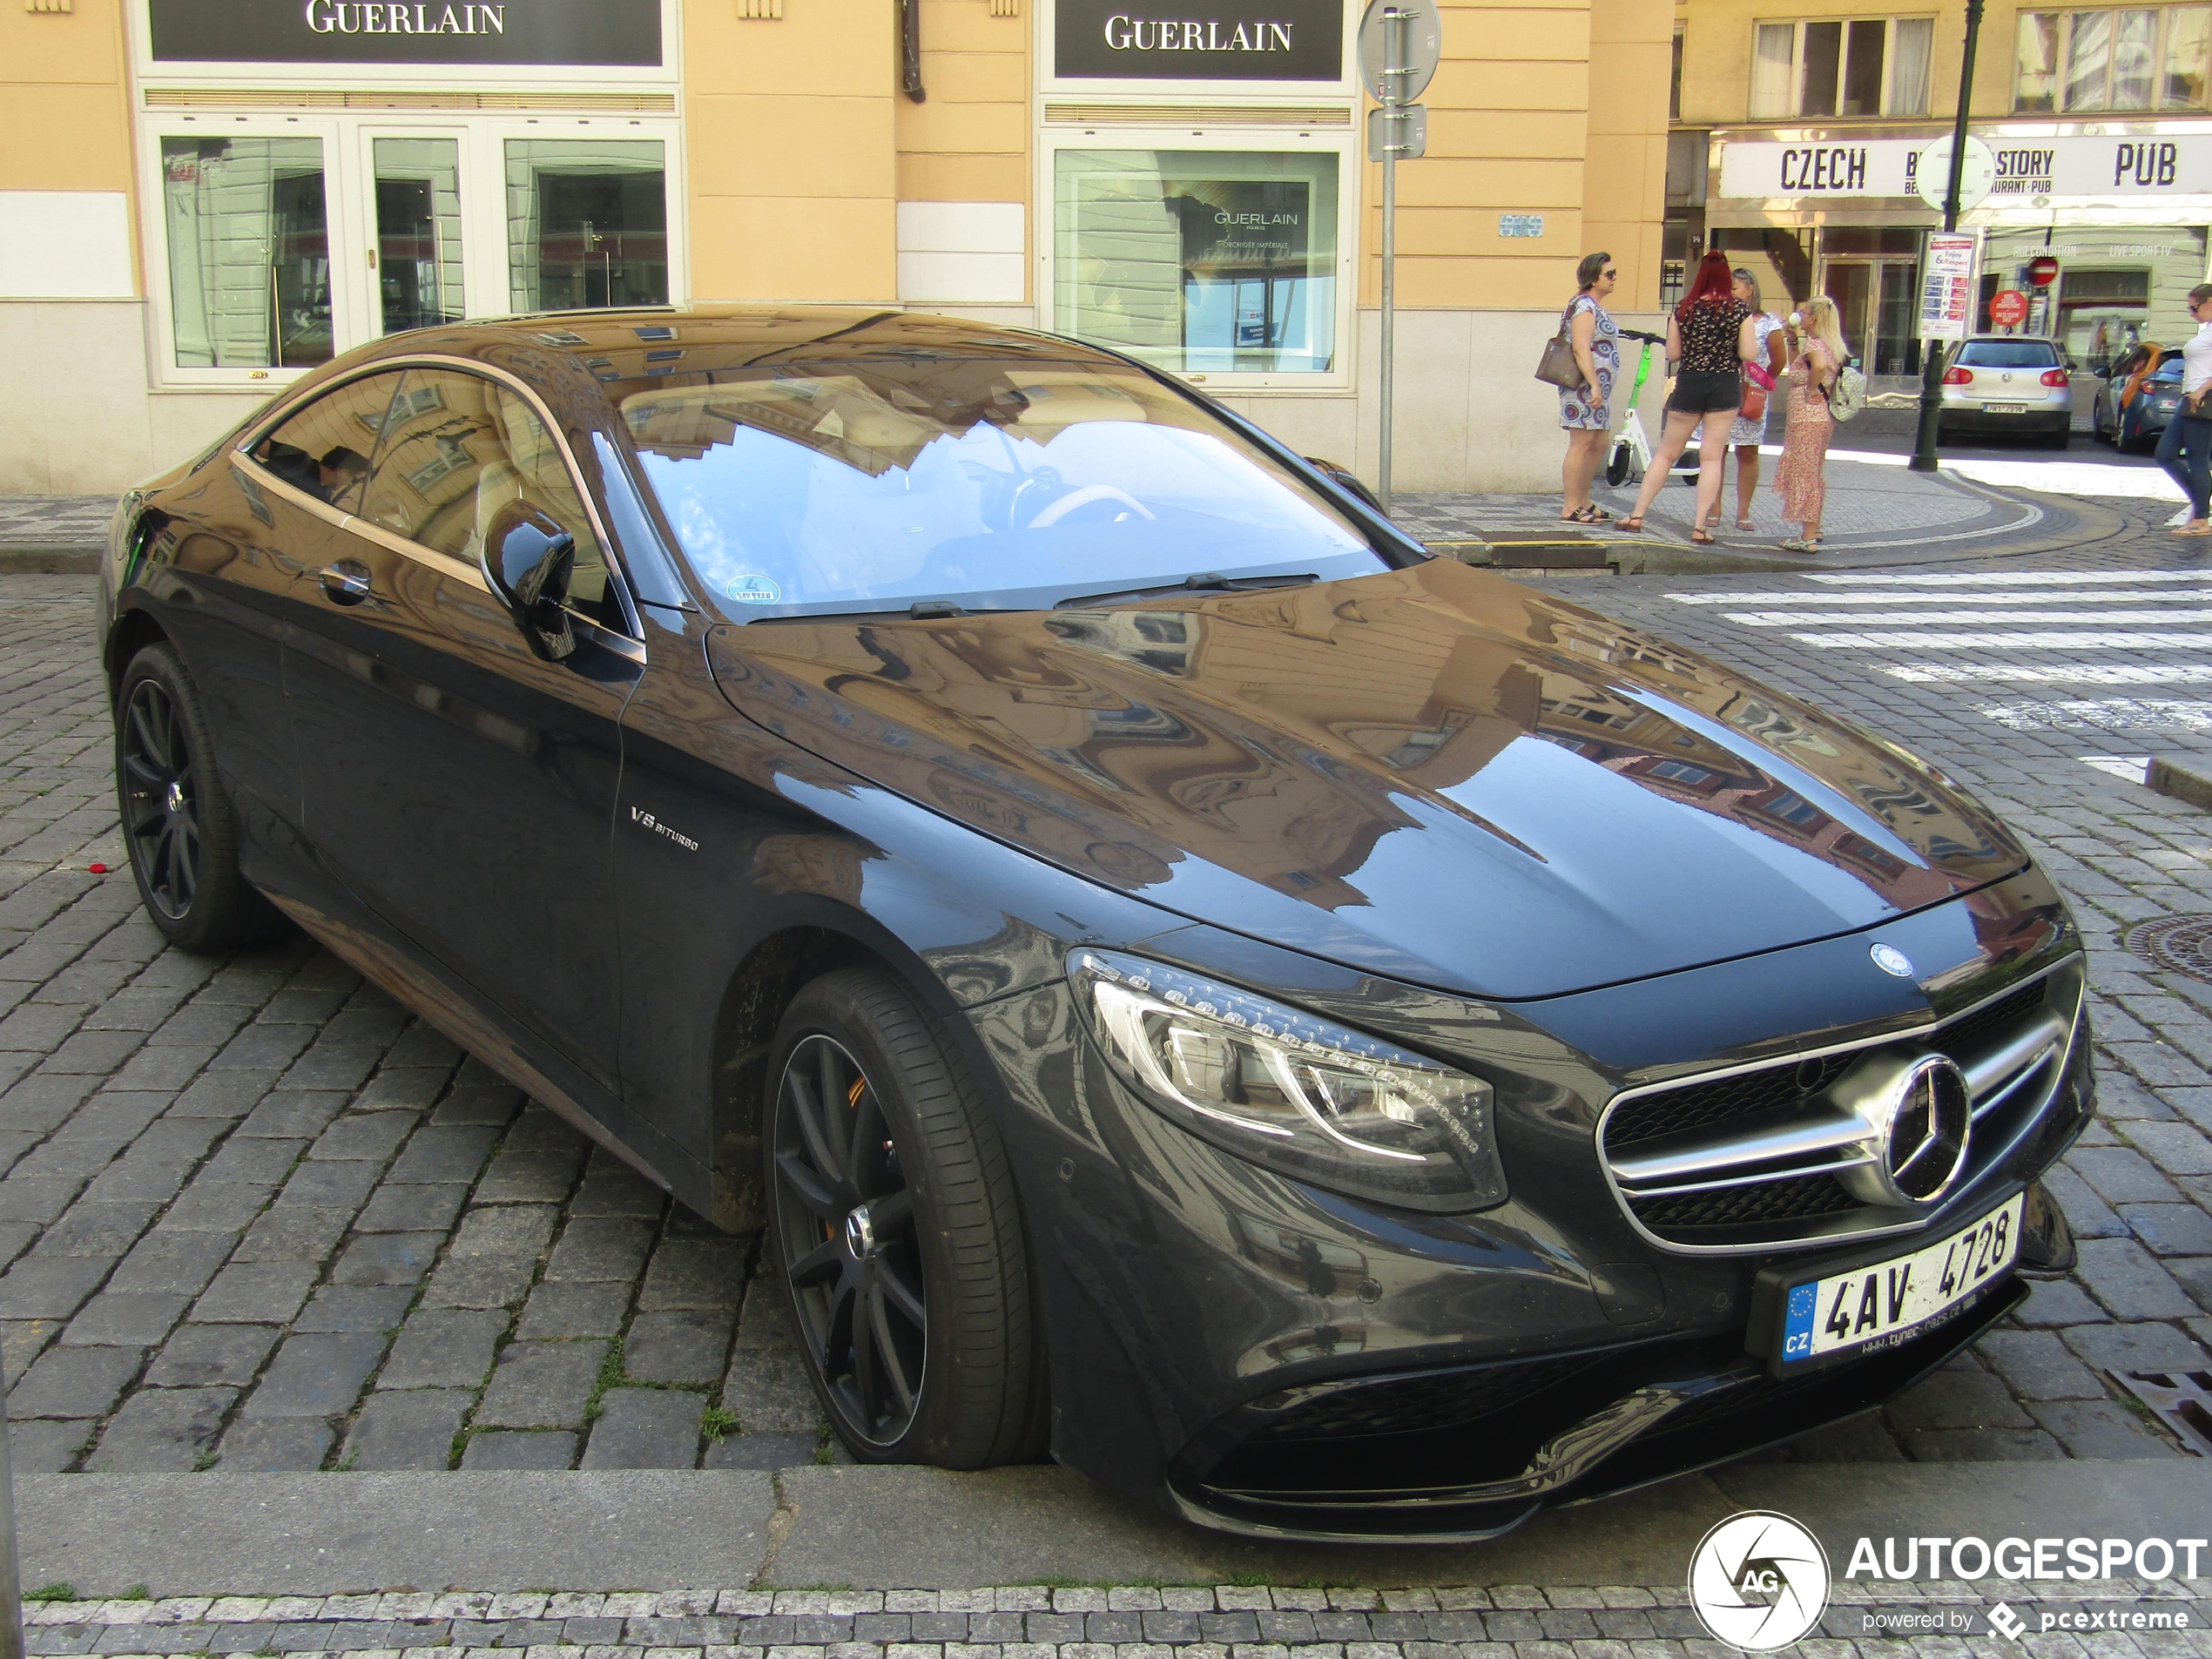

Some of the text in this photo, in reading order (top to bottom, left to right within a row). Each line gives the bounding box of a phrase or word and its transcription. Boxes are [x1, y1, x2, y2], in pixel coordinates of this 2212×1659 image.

[306, 0, 505, 34] GUERLAIN
[1104, 16, 1293, 52] GUERLAIN
[1781, 148, 1866, 190] CZECH
[1996, 150, 2054, 176] STORY
[2114, 143, 2176, 186] PUB
[1214, 212, 1298, 226] GUERLAIN
[2013, 246, 2027, 257] AIR
[2109, 245, 2128, 258] LIVE
[631, 806, 699, 852] V8 BITURBO
[1824, 1210, 2009, 1339] 4AV 4728
[1785, 1332, 1808, 1354] CZ
